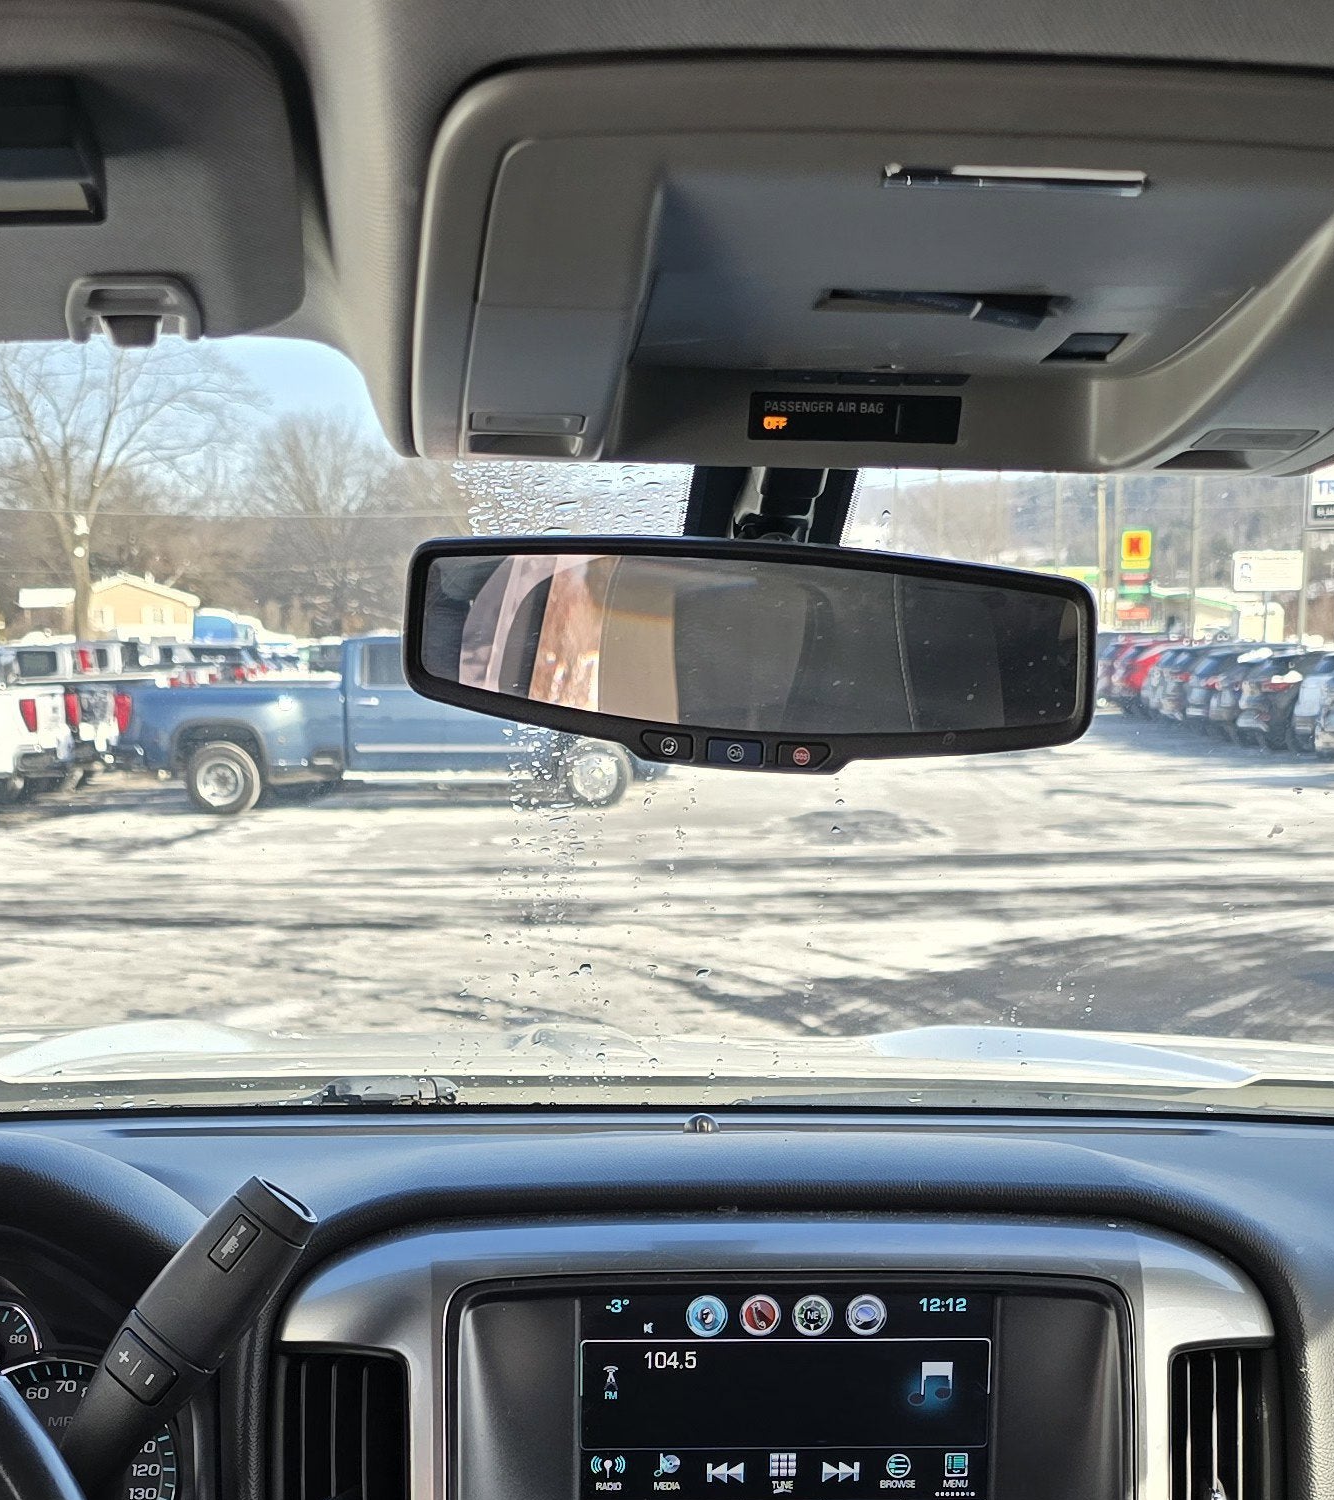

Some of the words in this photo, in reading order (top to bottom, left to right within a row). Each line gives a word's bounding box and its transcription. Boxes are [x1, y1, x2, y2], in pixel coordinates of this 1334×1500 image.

[764, 401, 834, 413] PASSENGER
[836, 402, 856, 413] AIR
[859, 402, 884, 414] BAG
[763, 416, 788, 430] OFF
[919, 1297, 968, 1313] 12:12
[806, 1310, 820, 1321] NE
[9, 1334, 27, 1345] 80
[644, 1350, 698, 1371] 104.5
[55, 1381, 77, 1393] 70
[25, 1387, 50, 1400] 60
[131, 1464, 161, 1477] 120
[595, 1482, 623, 1491] RADIO
[653, 1481, 681, 1491] MEDIA
[771, 1480, 794, 1490] TUNE
[879, 1479, 916, 1489] BROWSE
[942, 1479, 969, 1488] MENU
[128, 1487, 157, 1500] 130
